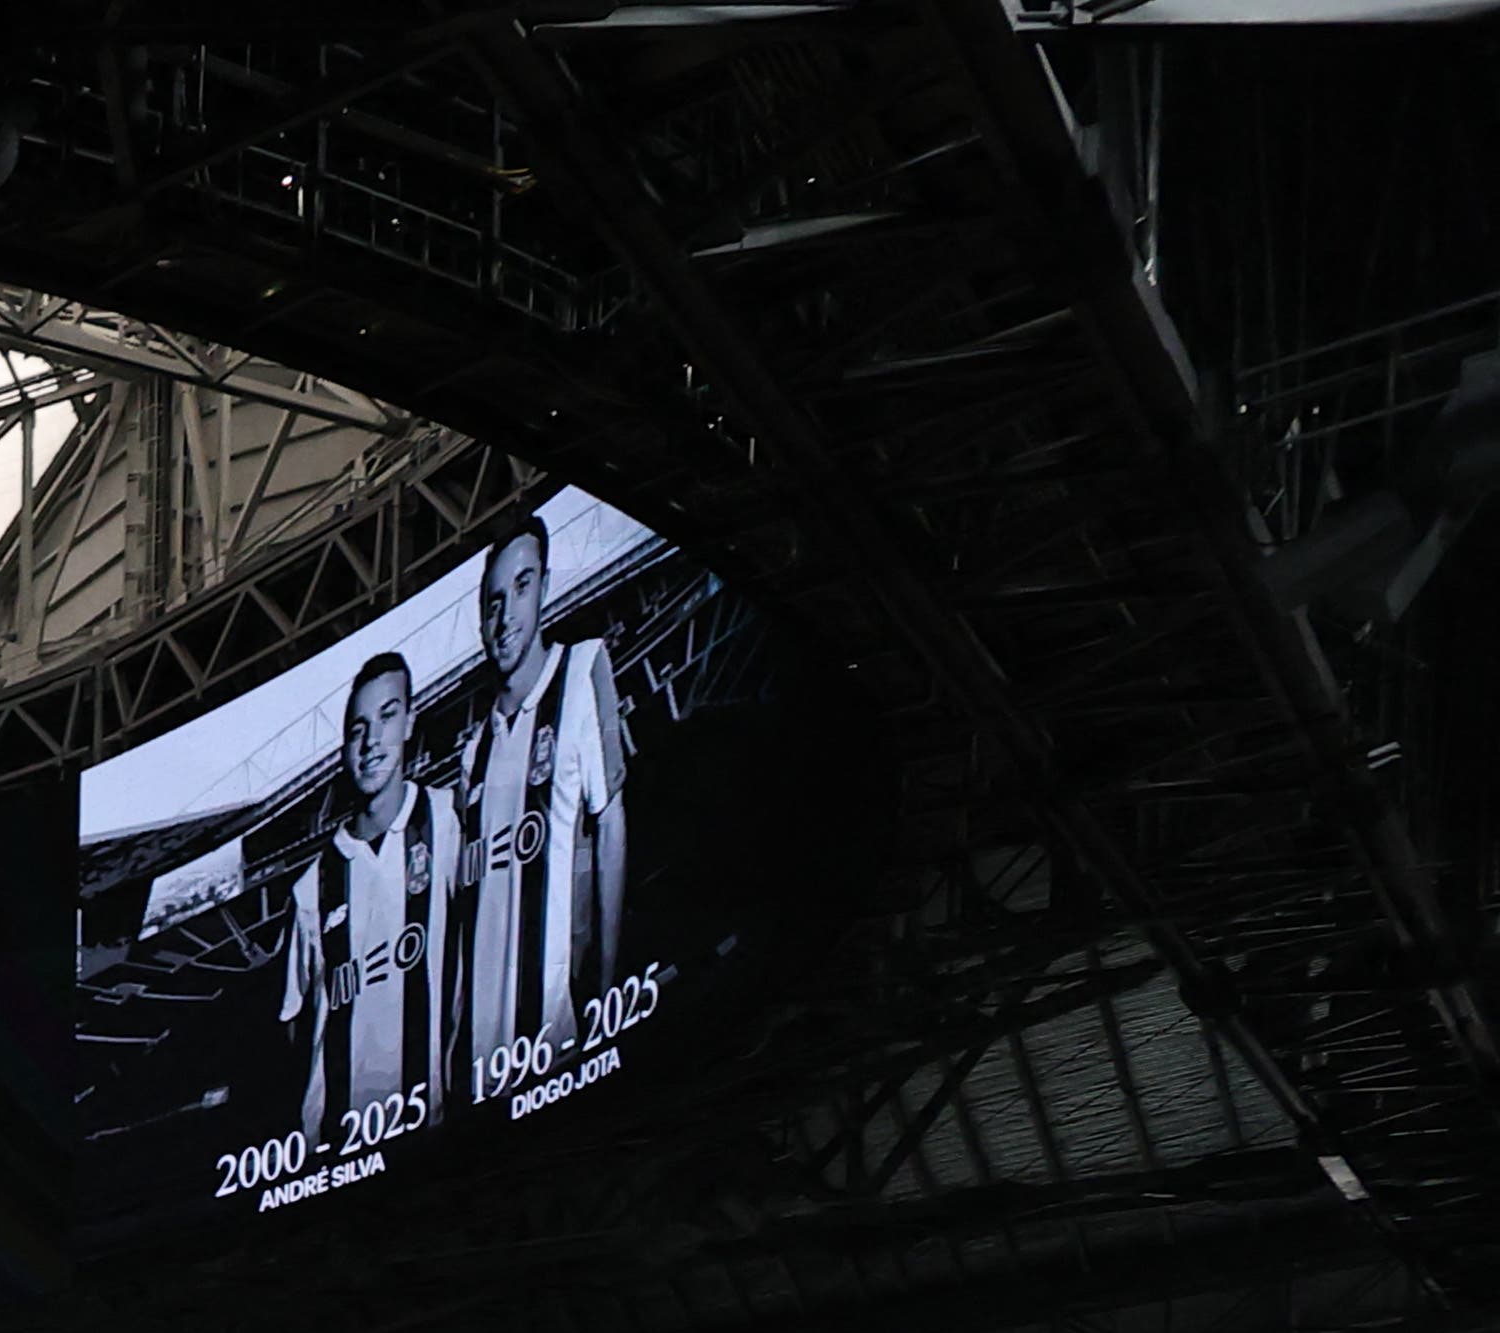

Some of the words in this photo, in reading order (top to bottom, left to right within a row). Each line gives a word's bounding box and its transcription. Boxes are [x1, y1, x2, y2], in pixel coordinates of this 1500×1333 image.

[472, 1022, 552, 1105] 1996
[561, 1038, 575, 1050] -
[582, 961, 660, 1052] 2025
[511, 1070, 574, 1120] DIOGO
[574, 1046, 621, 1089] JOTA
[214, 1130, 306, 1198] 2000
[315, 1142, 331, 1154] -
[340, 1082, 427, 1156] 2025
[259, 1165, 329, 1212] ANDRÉ
[330, 1151, 386, 1187] SILVA
